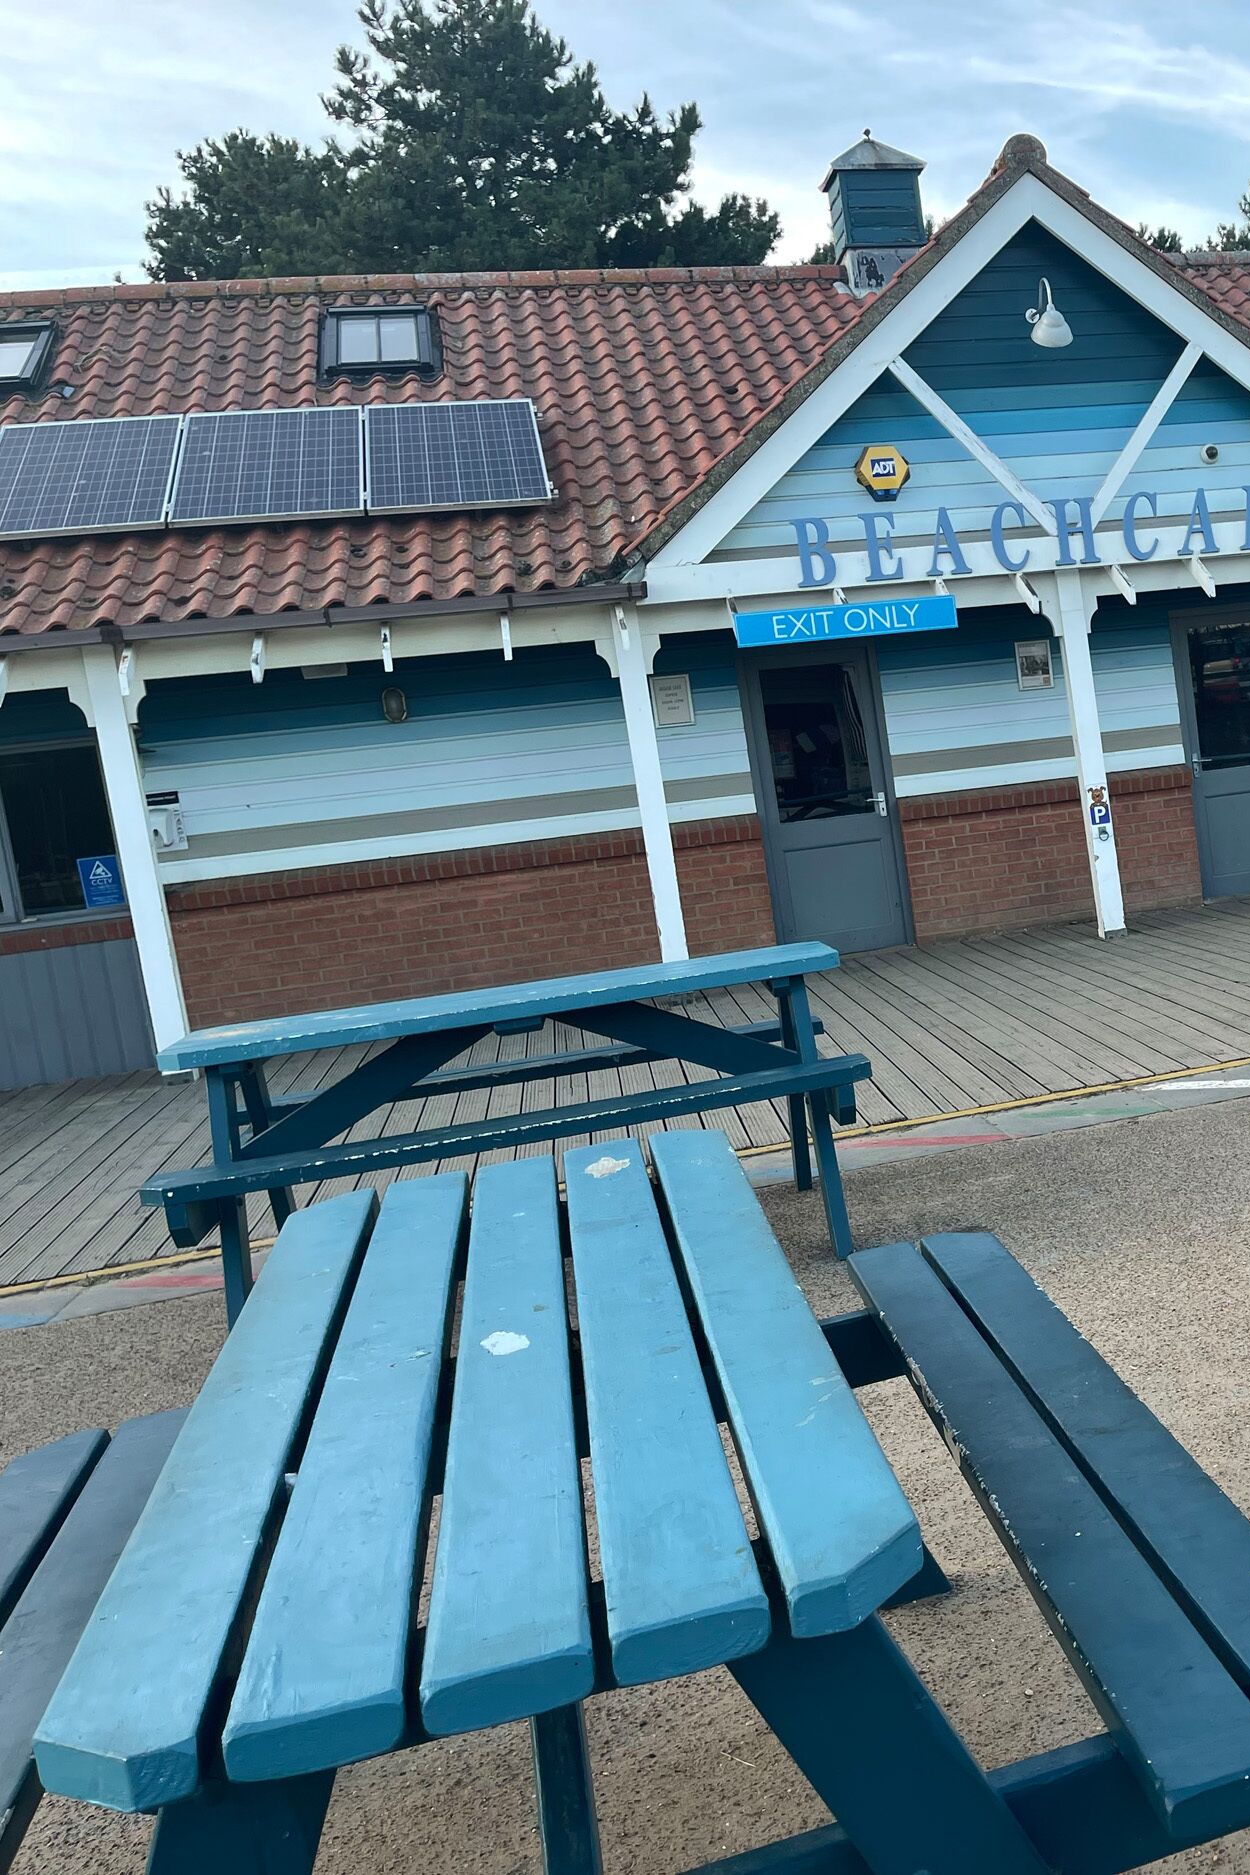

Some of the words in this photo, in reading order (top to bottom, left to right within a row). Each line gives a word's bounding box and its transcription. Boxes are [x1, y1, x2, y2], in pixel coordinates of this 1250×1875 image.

[872, 461, 895, 475] ADT
[772, 611, 834, 639] EXIT
[844, 603, 919, 632] ONLY
[1094, 806, 1106, 824] P
[91, 877, 112, 886] CCTV
